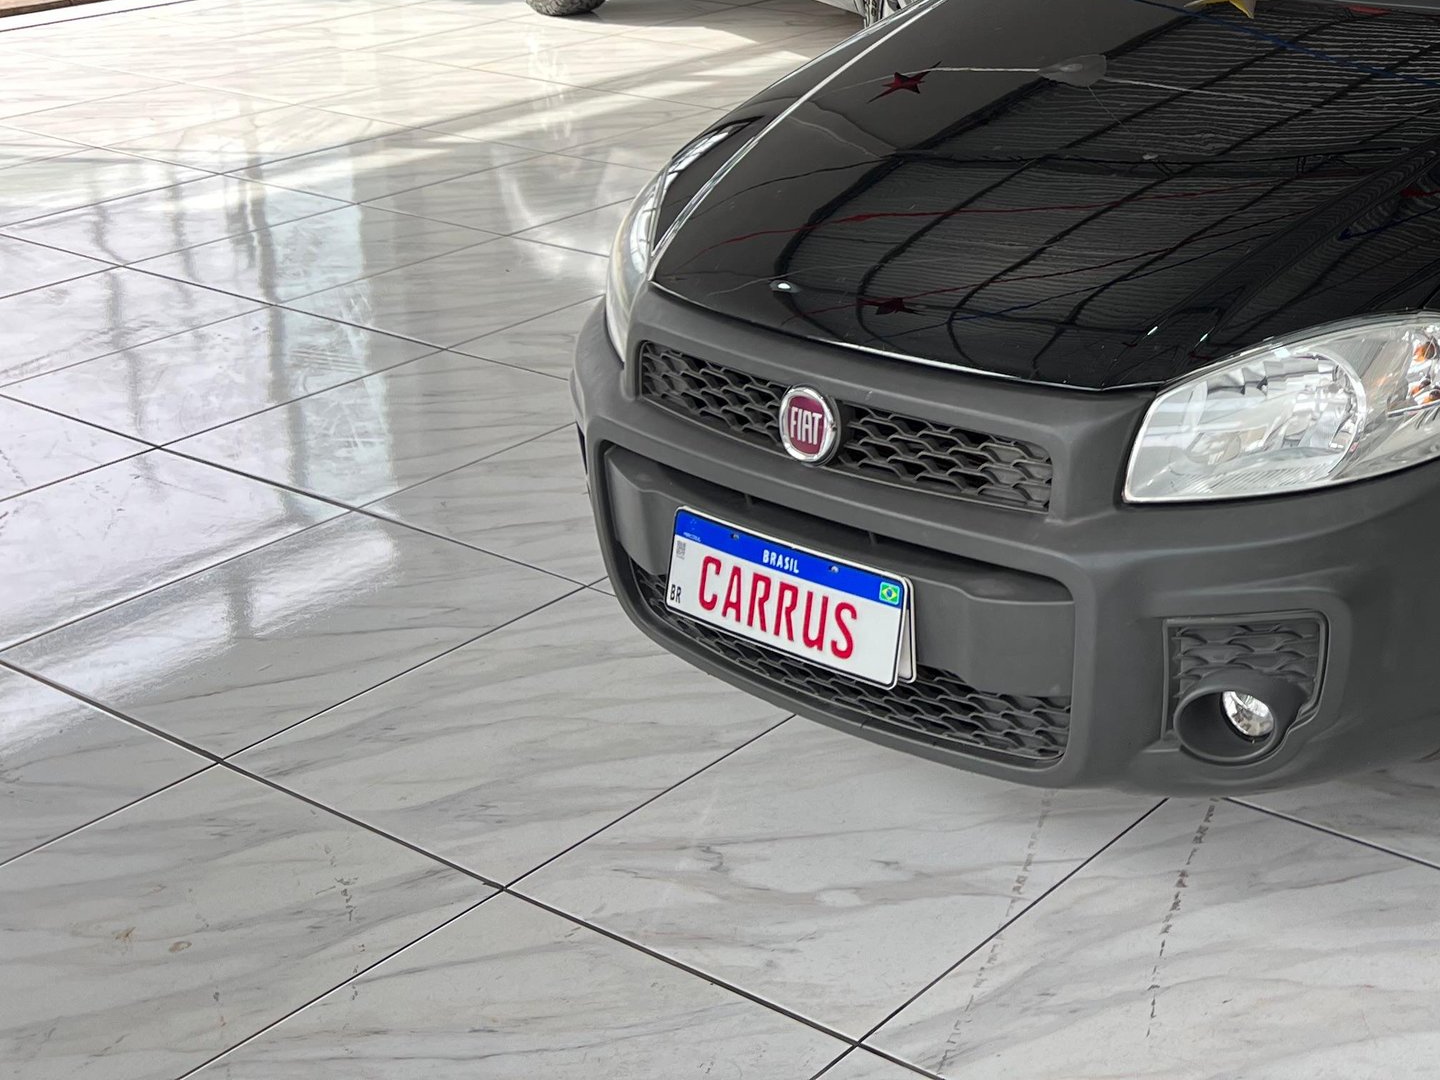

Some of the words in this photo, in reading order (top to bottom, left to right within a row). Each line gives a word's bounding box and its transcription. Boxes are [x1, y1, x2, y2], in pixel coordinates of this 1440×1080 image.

[790, 406, 823, 445] FIAT
[762, 549, 800, 574] BRASIL
[670, 583, 682, 604] BR
[698, 555, 858, 659] CARRUS
